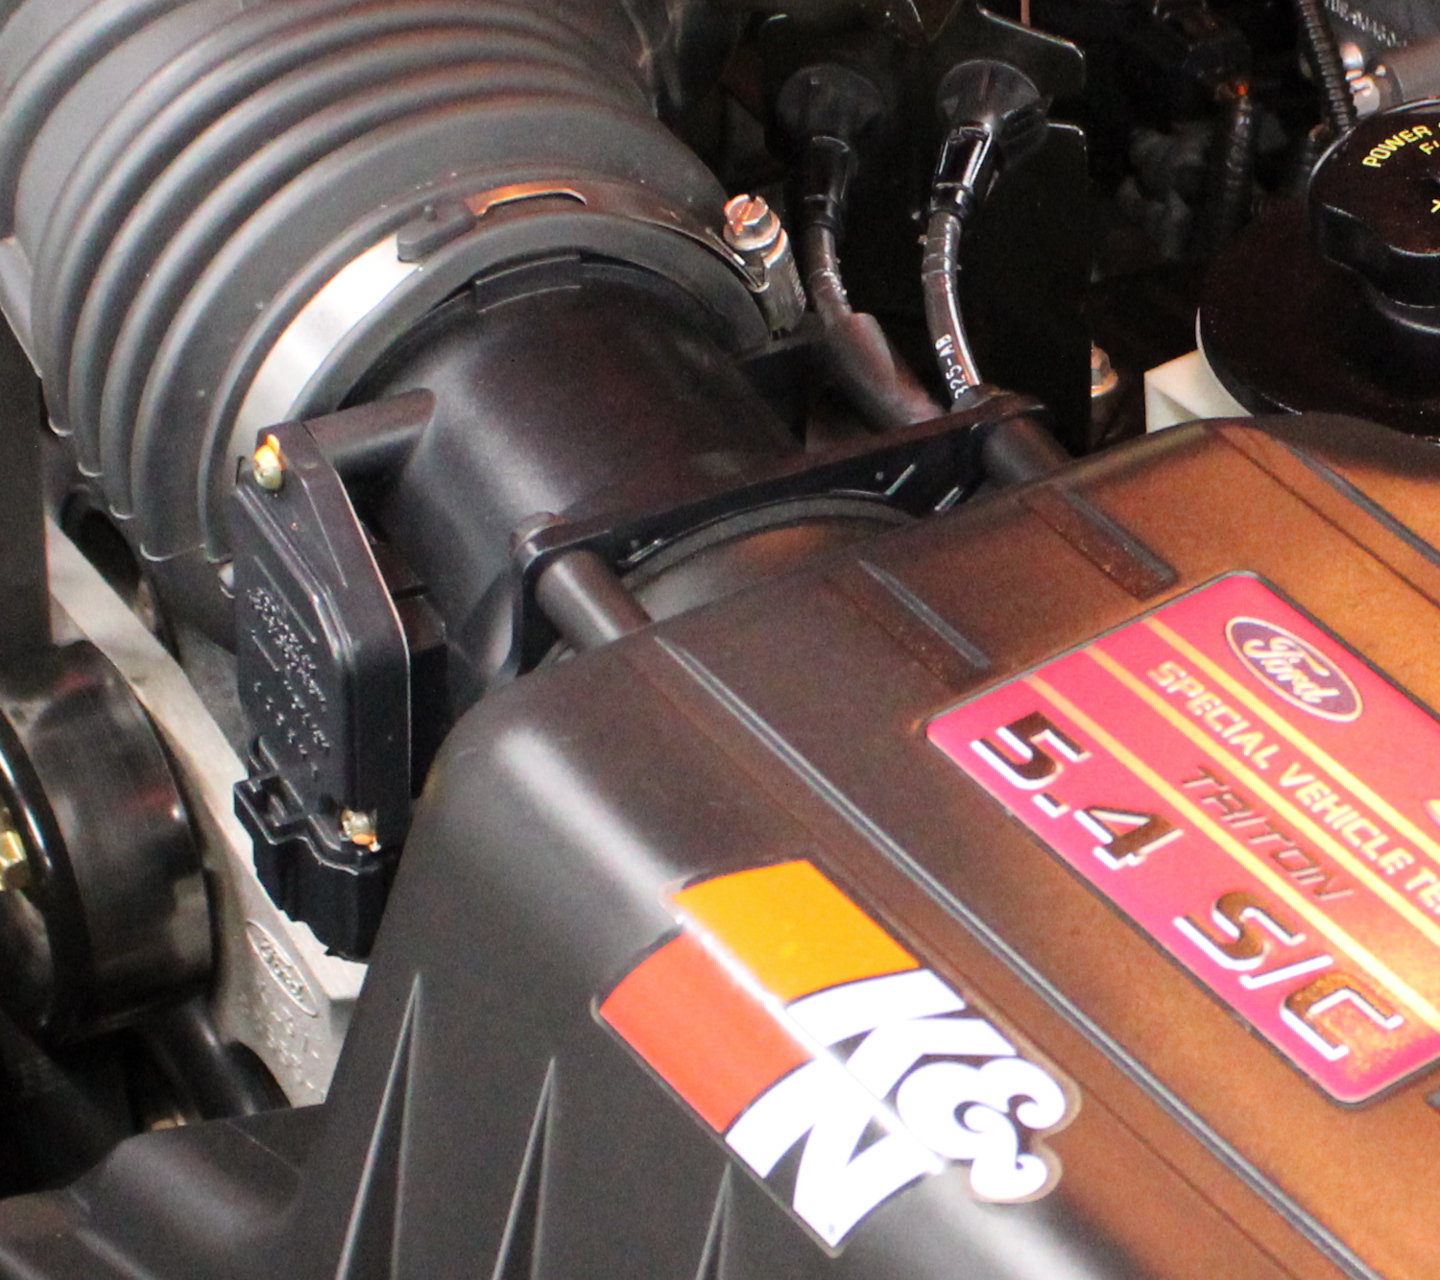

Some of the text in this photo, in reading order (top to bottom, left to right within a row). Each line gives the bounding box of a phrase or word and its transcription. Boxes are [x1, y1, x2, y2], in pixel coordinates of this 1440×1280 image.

[1362, 125, 1433, 168] POWER
[1244, 633, 1344, 708] Ford
[1148, 660, 1278, 773] SPECIAL
[1275, 760, 1415, 878] VEHICLE
[1180, 764, 1358, 904] TRITON
[970, 709, 1403, 1063] 5.4 S/C
[725, 968, 1066, 1248] K&N
